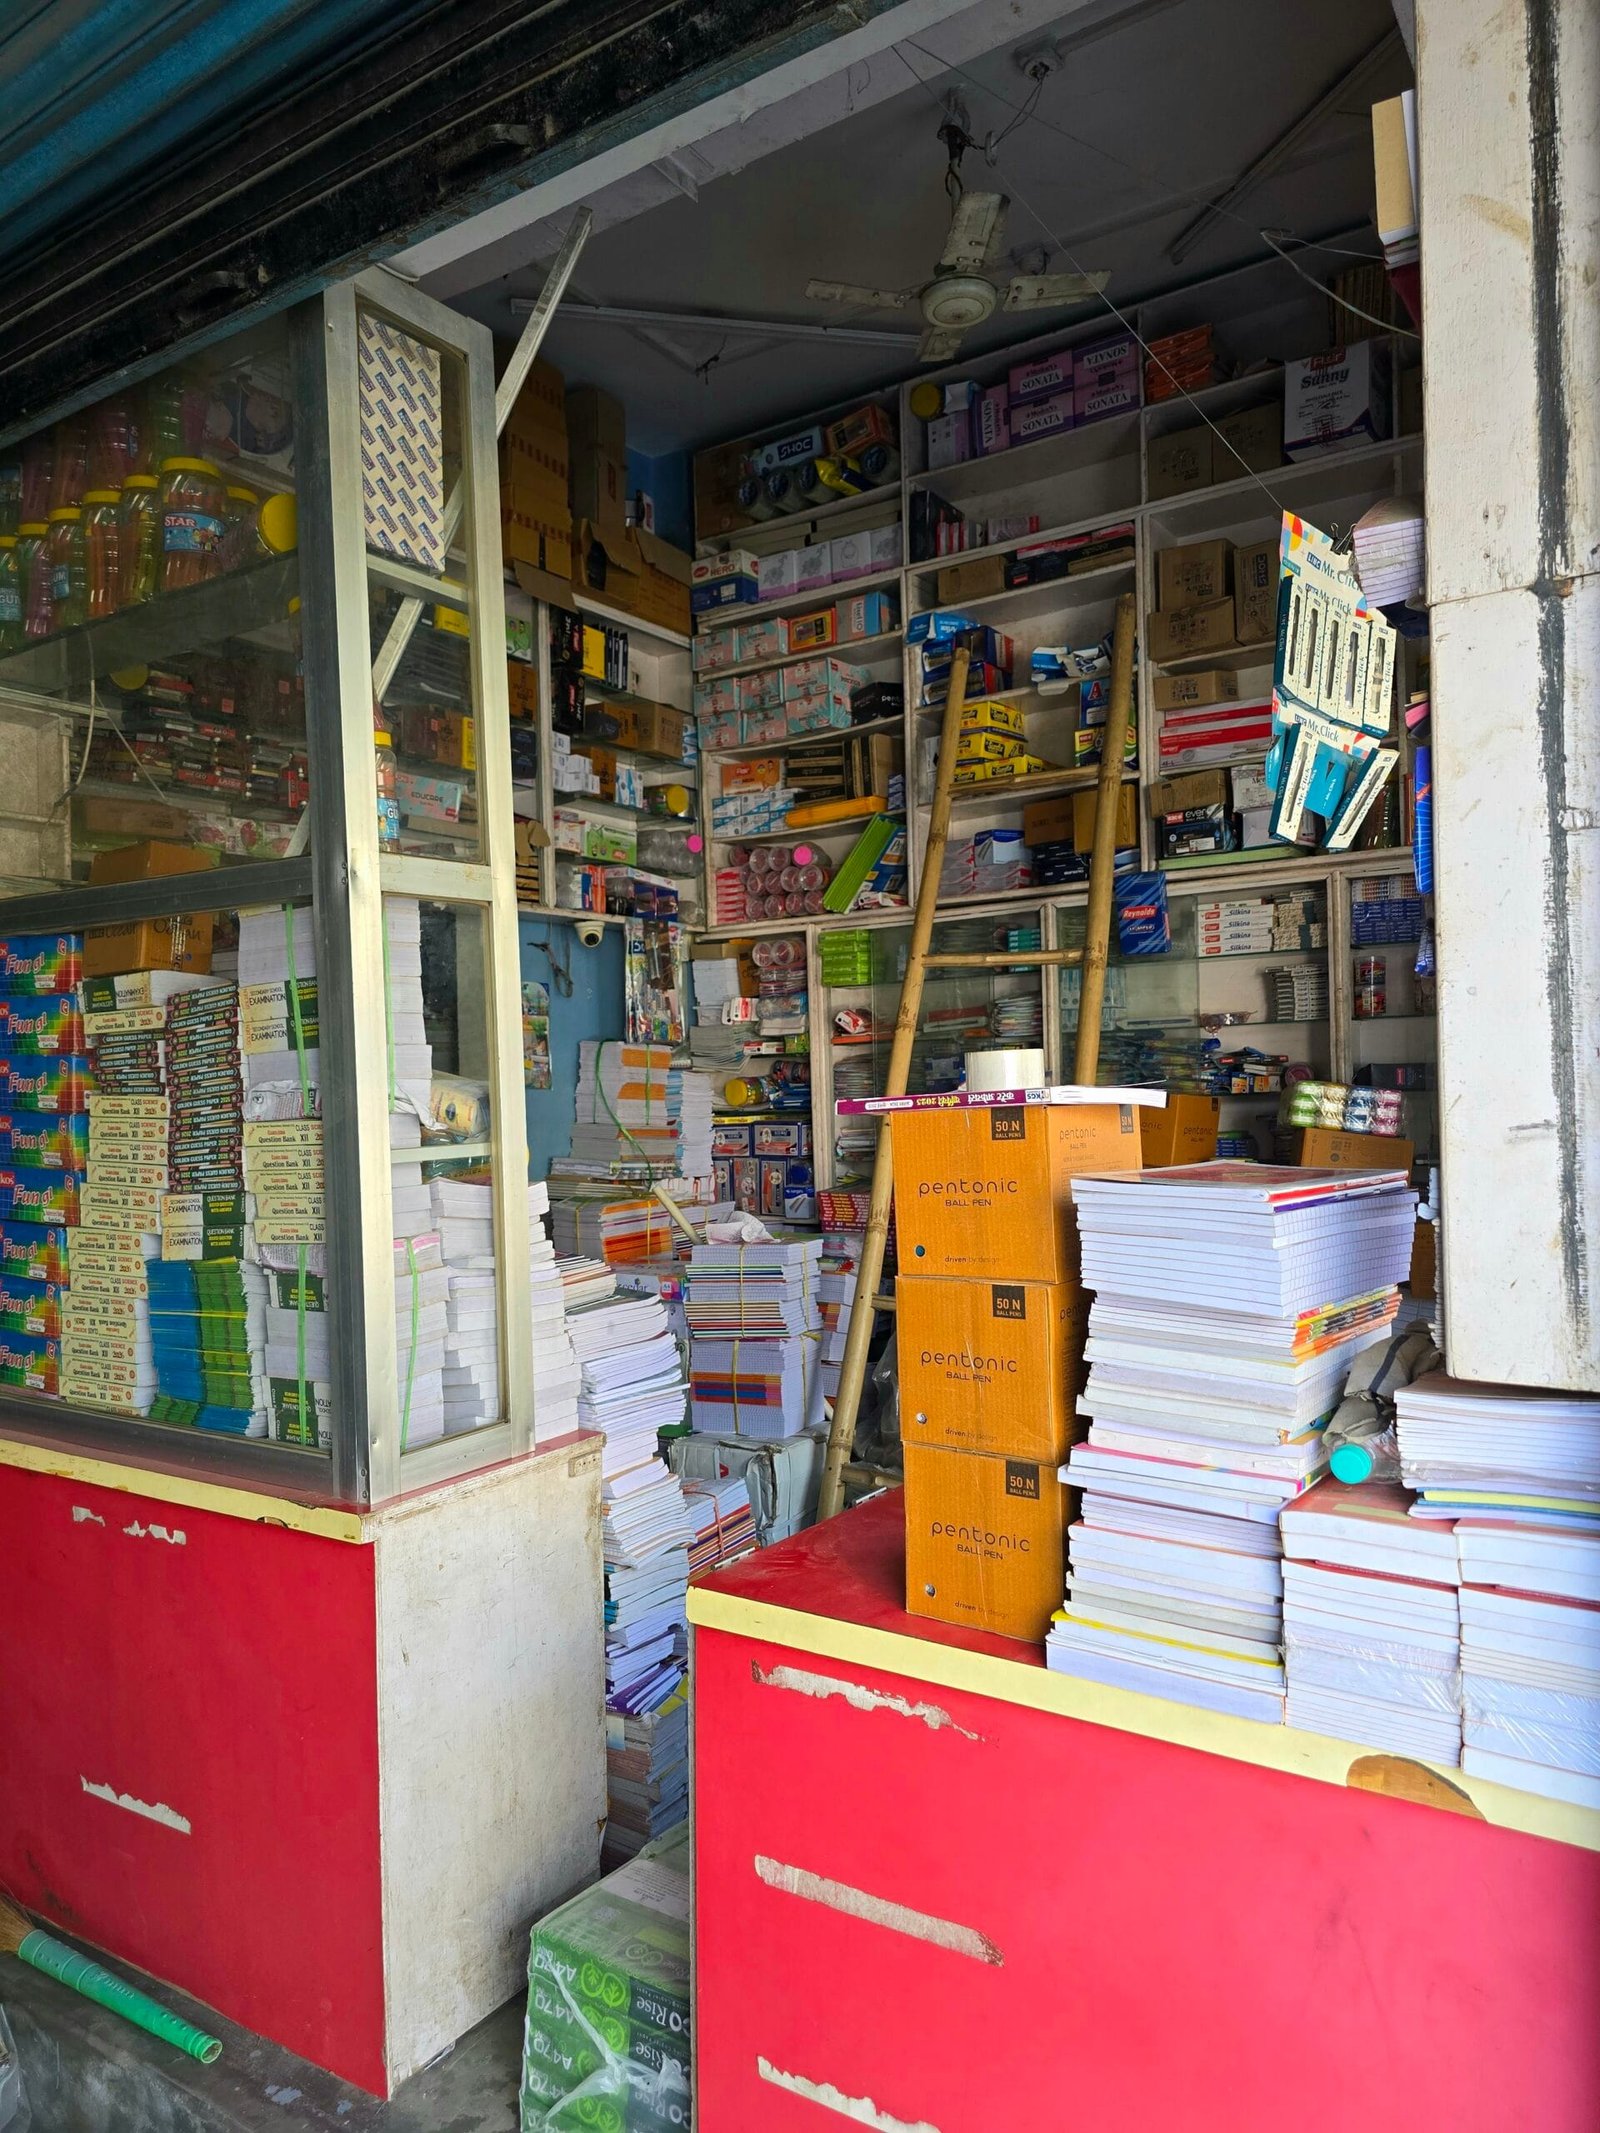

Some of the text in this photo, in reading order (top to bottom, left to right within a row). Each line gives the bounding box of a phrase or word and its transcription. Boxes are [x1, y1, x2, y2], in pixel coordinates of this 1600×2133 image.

[1086, 345, 1129, 366] SONATA
[1021, 372, 1060, 391] SONATA
[1301, 367, 1350, 389] Sunny
[1087, 392, 1128, 411] SONATA
[983, 400, 993, 444] SONATA
[1022, 414, 1060, 432] SONATA
[164, 515, 196, 528] STAR
[710, 562, 735, 576] HERO
[1307, 552, 1321, 569] LINC
[1319, 724, 1340, 743] Click
[1123, 908, 1156, 918] Reynolds
[5, 954, 33, 975] Fun
[7, 1013, 34, 1035] Fun
[8, 1072, 34, 1093] Fun
[917, 1096, 937, 1106] 2025
[995, 1121, 1020, 1132] 50 N
[1060, 1127, 1096, 1140] pentonic
[11, 1129, 38, 1150] Fun
[13, 1184, 40, 1206] Fun
[919, 1178, 1018, 1198] pentonic
[945, 1199, 992, 1207] BALL PEN
[3, 1238, 27, 1260] Fun
[945, 1256, 966, 1264] driven
[997, 1298, 1020, 1310] 50 N
[921, 1351, 1017, 1373] pentonic
[946, 1372, 992, 1383] BALL PEN
[945, 1428, 966, 1438] driven
[1010, 1477, 1034, 1489] 50 N
[932, 1521, 1030, 1552] pentonic
[957, 1544, 1003, 1560] BALL PEN
[955, 1601, 976, 1611] driven
[637, 1996, 667, 2027] Rise
[635, 2092, 666, 2118] Rise
